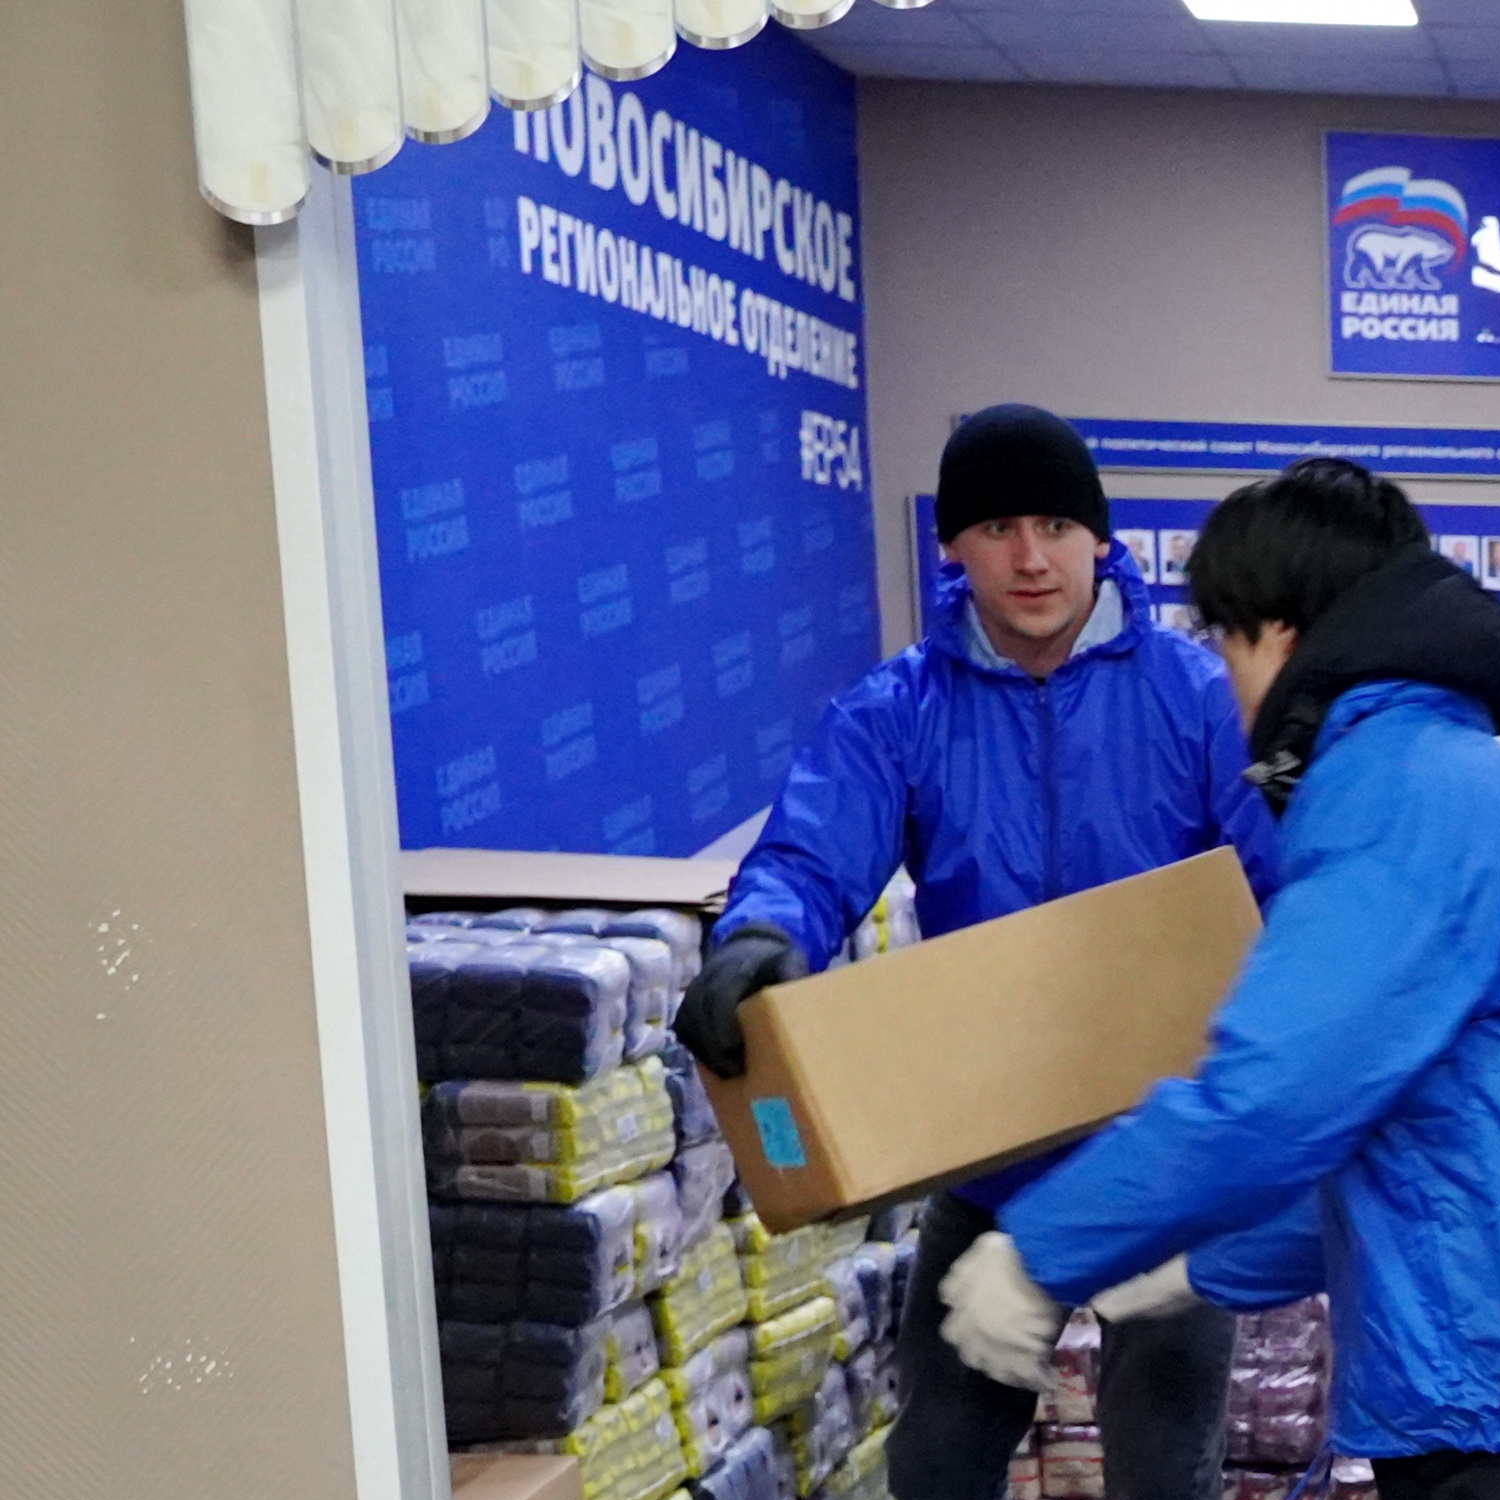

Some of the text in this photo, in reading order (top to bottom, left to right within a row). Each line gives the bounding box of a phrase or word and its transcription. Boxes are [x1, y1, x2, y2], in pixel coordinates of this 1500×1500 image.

[517, 196, 739, 346] РЕГИОНАЛЬНОЕ
[740, 288, 858, 389] ОТДЕЛЕНИЕ
[1341, 291, 1459, 316] ЕДИНАЯ
[1341, 316, 1460, 342] РОССИЯ
